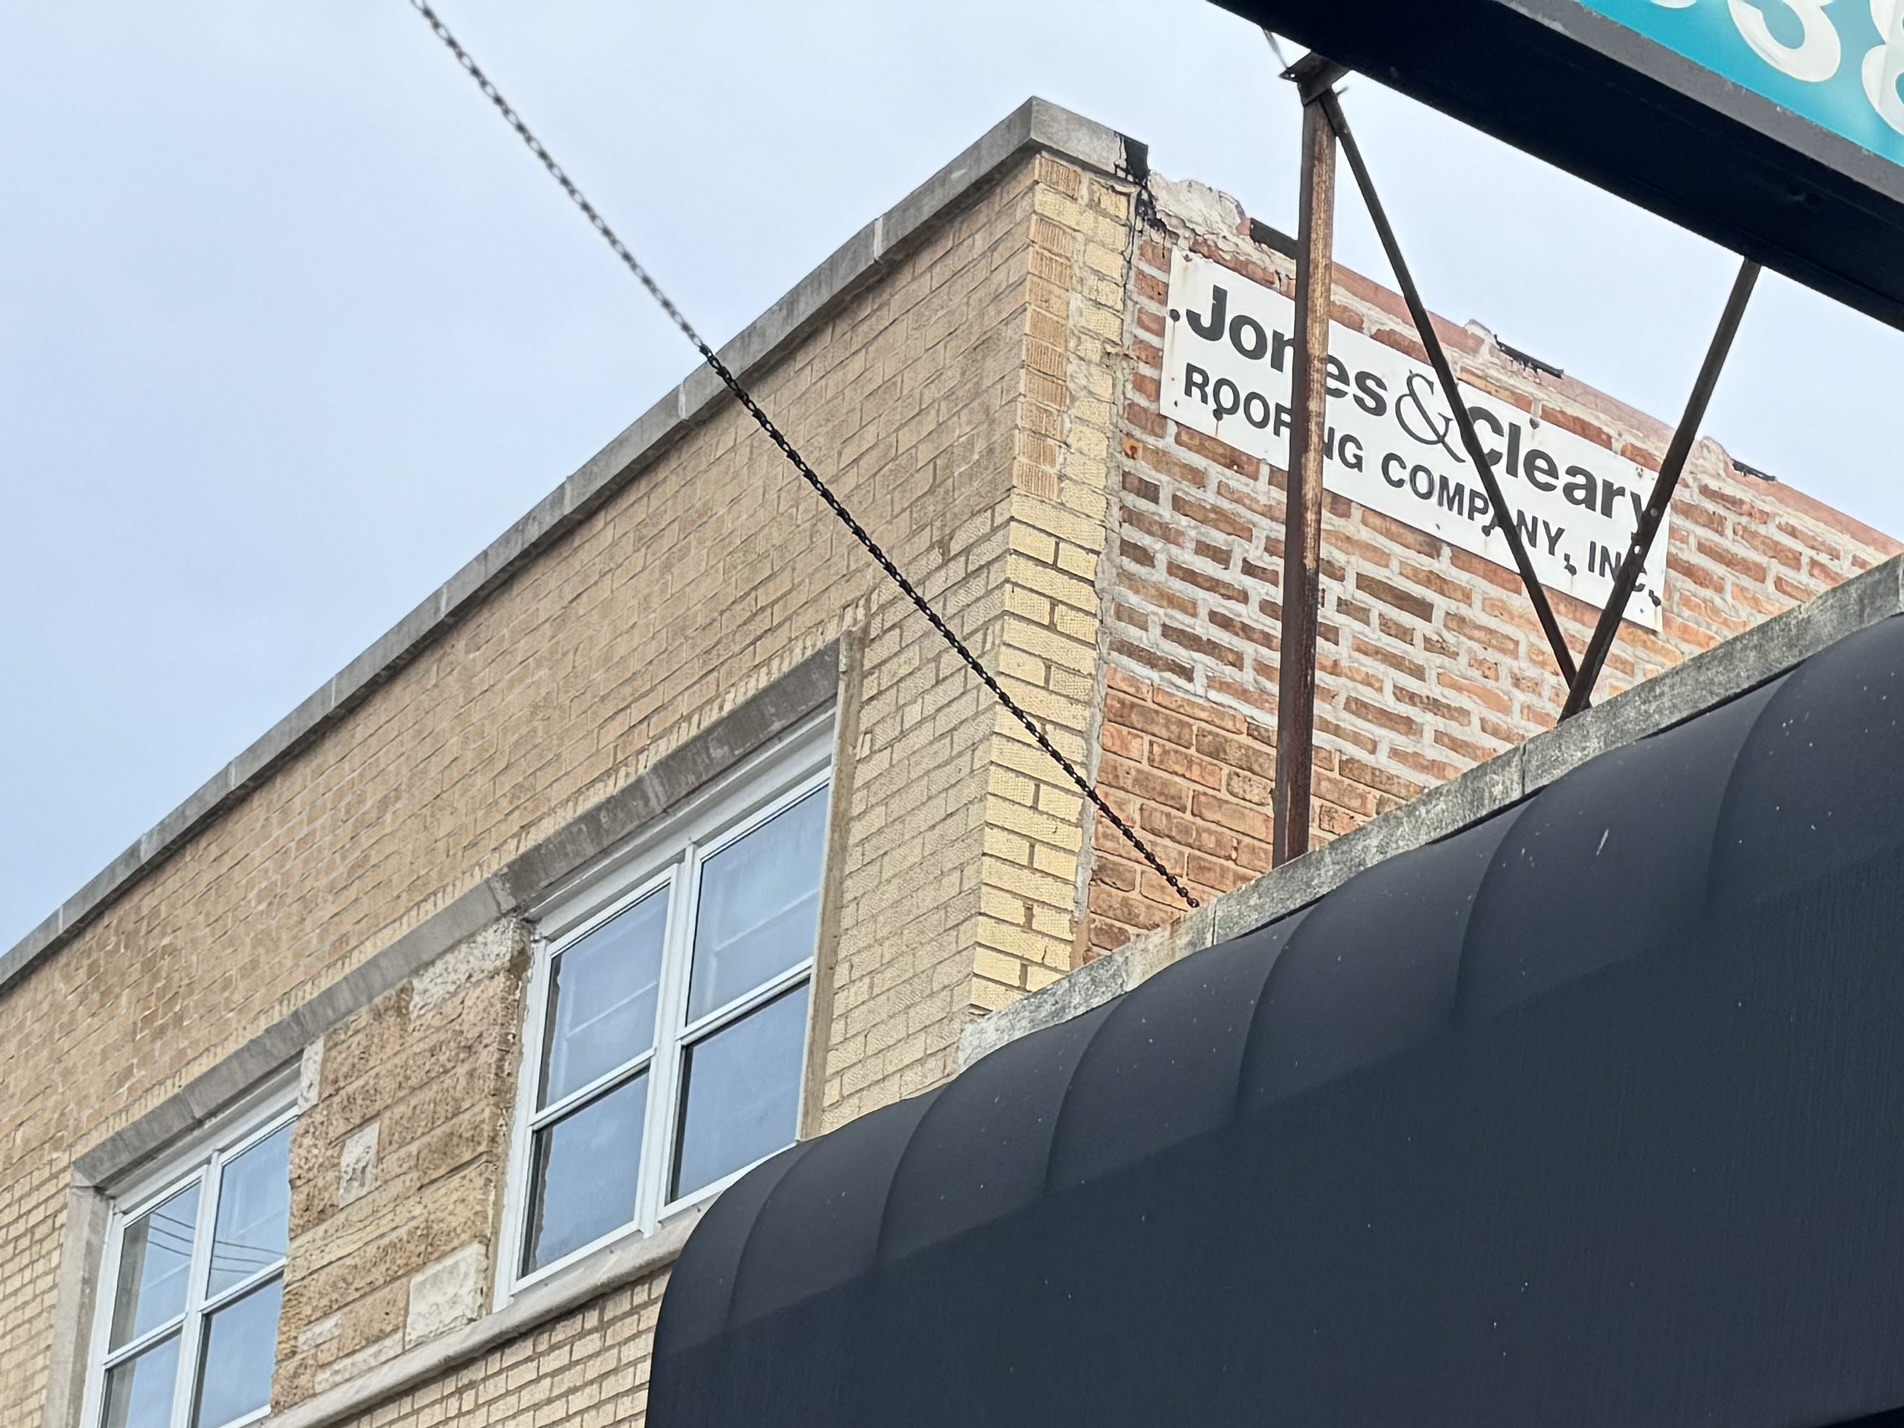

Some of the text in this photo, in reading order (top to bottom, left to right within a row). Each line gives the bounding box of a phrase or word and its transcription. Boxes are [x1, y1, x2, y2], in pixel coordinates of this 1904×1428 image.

[1184, 362, 1661, 606] ROOFG COMPNY, IN.
[1395, 369, 1466, 463] &
